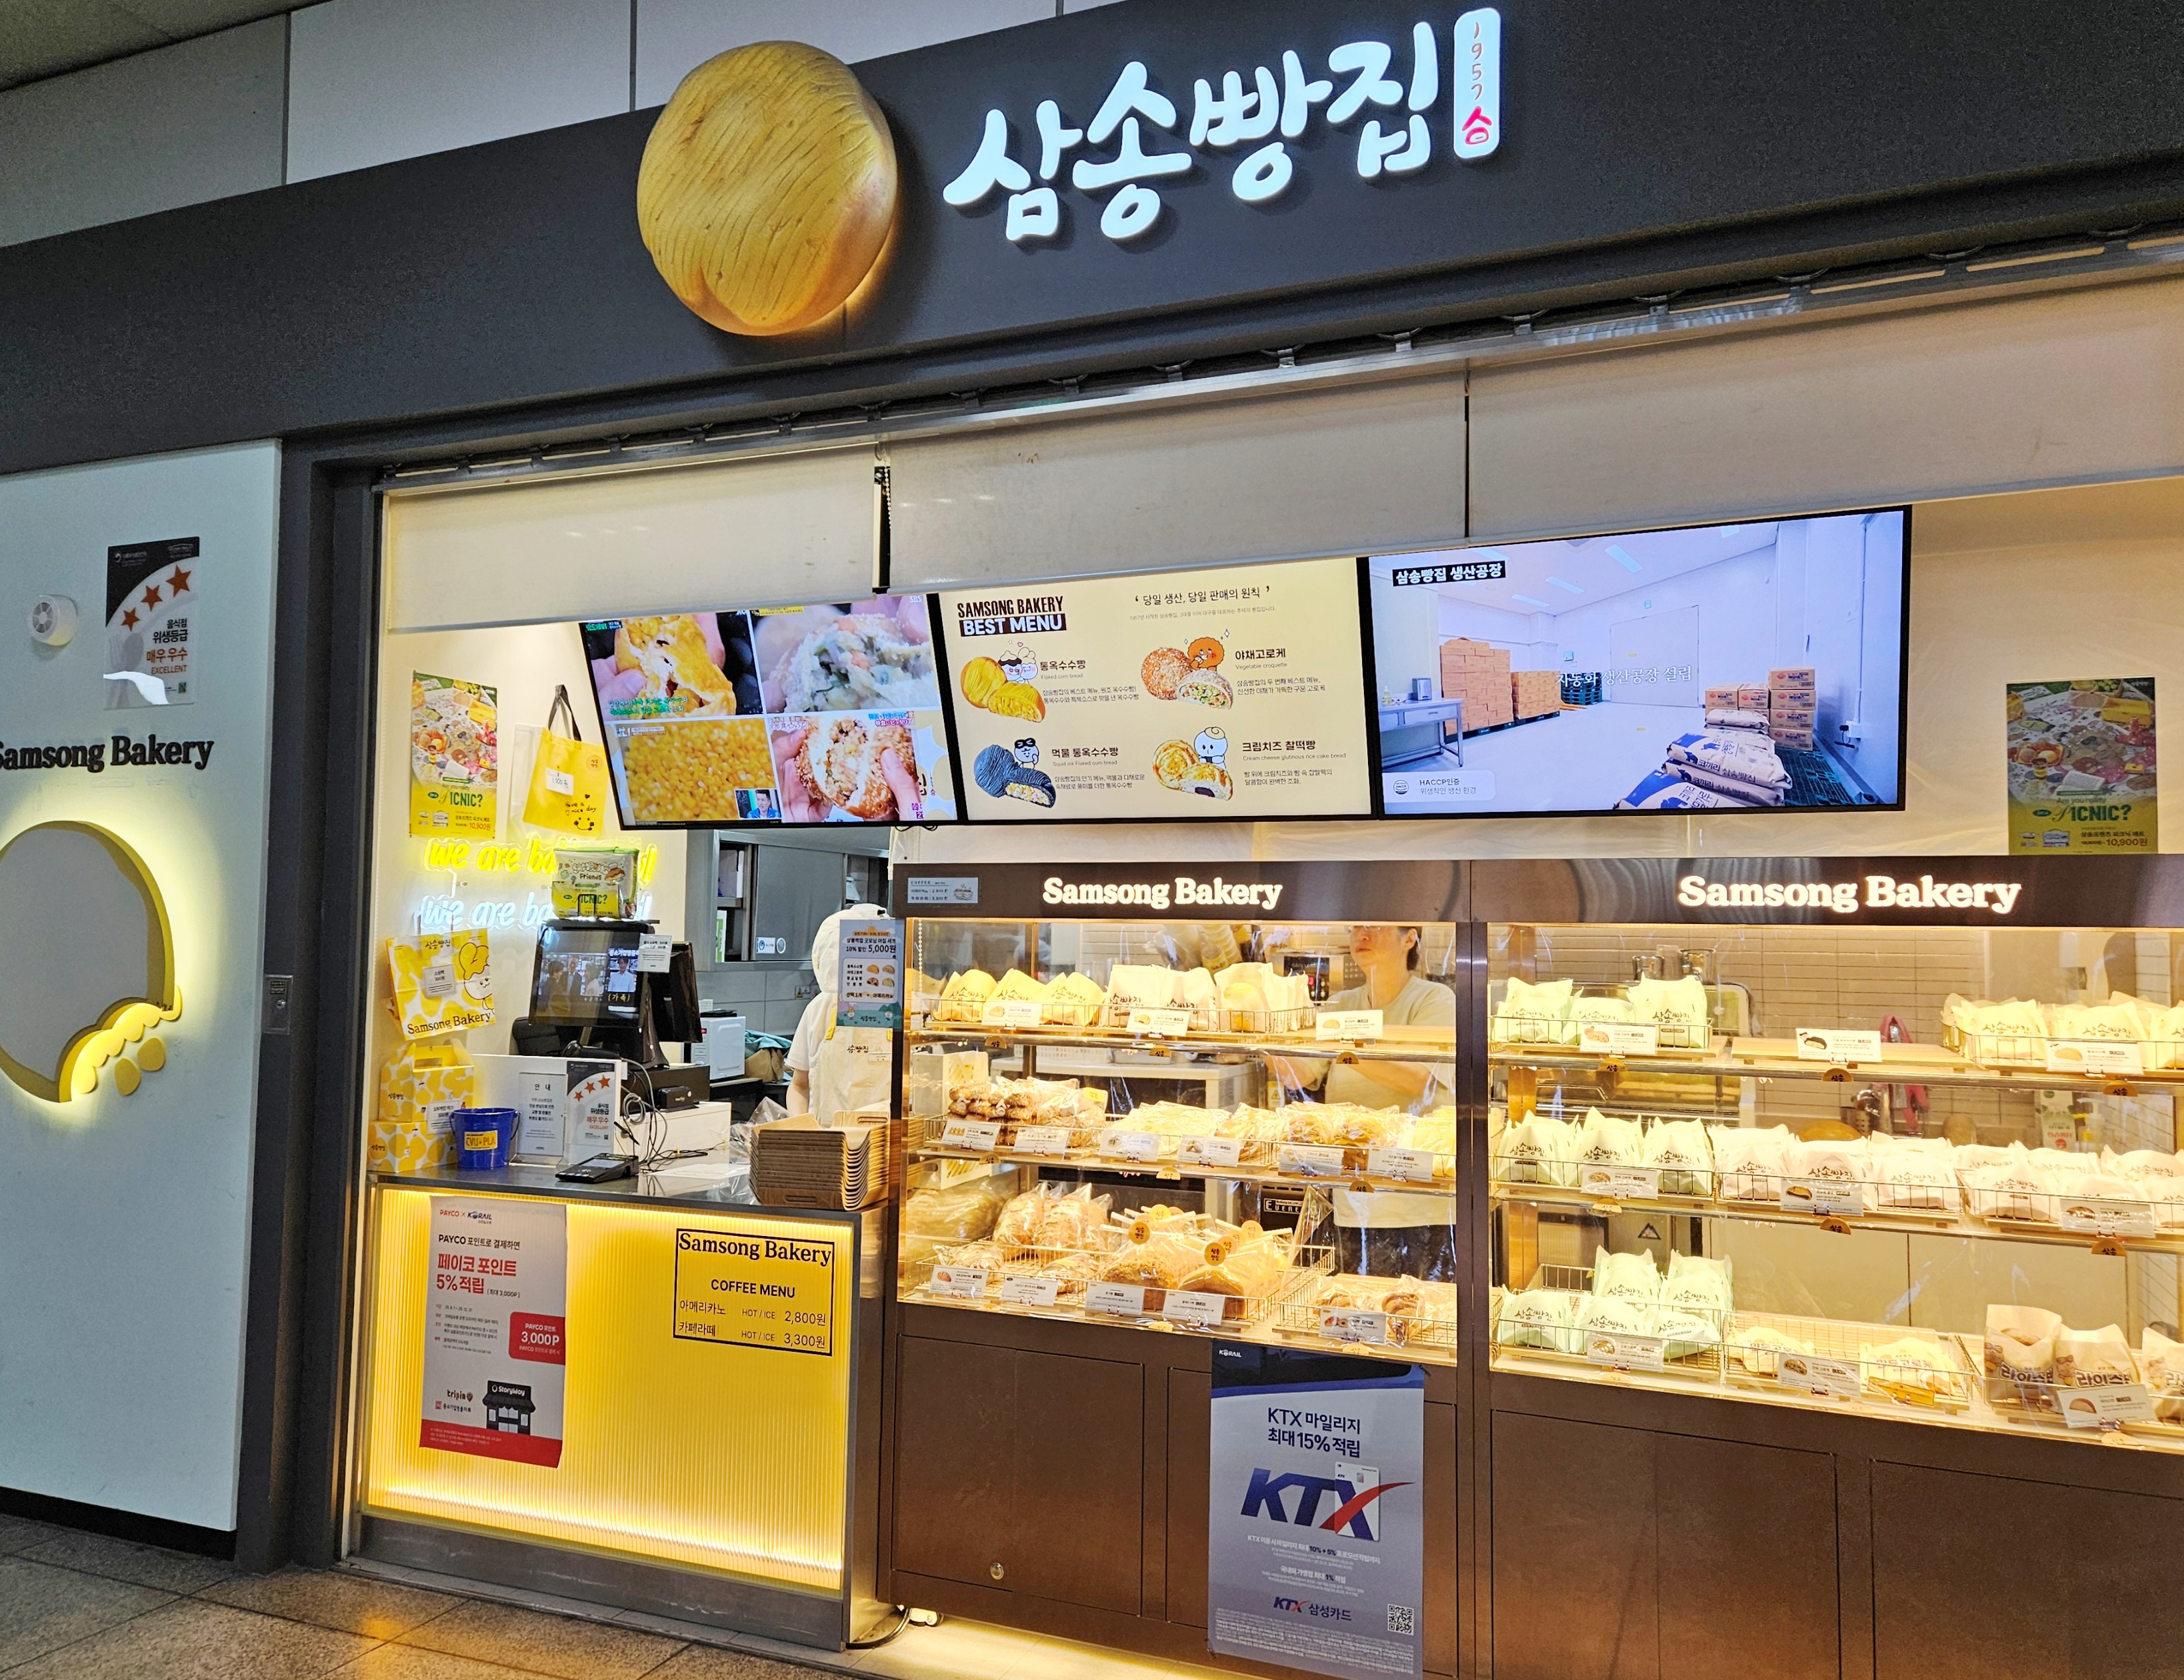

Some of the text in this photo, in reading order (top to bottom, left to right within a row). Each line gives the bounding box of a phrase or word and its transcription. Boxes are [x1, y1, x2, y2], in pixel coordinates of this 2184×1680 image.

[1471, 22, 1482, 100] 1957
[943, 21, 1437, 241] 삼송빵집
[1396, 561, 1503, 585] 삼송빵집 생산공장
[1143, 587, 1260, 605] 당일 생산, 당일 판매의 원칙
[957, 596, 1063, 618] SAMSONG BAKERY
[167, 619, 187, 629] 음식점
[963, 615, 1062, 635] BEST MENU
[153, 629, 188, 643] 위생등급
[147, 647, 187, 663] 매우 우수
[1235, 648, 1286, 660] 야채고로케
[151, 665, 187, 675] EXCELLENT
[1040, 660, 1085, 671] 통옥수수빵
[1555, 664, 1693, 688] 자동화 생산공장 설립
[111, 734, 215, 770] Bakery
[1051, 747, 1118, 758] 먹물 통옥수수빵
[1243, 740, 1315, 752] 크림치즈 찰떡빵
[1699, 759, 1756, 783] 코끼리 삼송빵집
[1419, 777, 1460, 787] HACCP인증
[1419, 786, 1477, 795] 위생적인 생산 환경
[469, 823, 491, 831] 10,900원
[2106, 838, 2148, 847] 10,900원
[428, 839, 470, 869] we
[477, 844, 522, 872] are
[1043, 877, 1283, 910] Samsong Bakery
[1678, 875, 2022, 914] Samsong Bakery
[421, 898, 516, 927] we are
[425, 939, 451, 949] 삼송빵집
[868, 945, 896, 953] 5,000원
[1652, 1008, 1692, 1023] 삼송빵집
[407, 1013, 491, 1034] Samsong Bakery
[1982, 1021, 2032, 1035] 삼송빵집
[2082, 1023, 2134, 1038] 삼송빵집
[1509, 1142, 1547, 1157] 삼송빵집
[1583, 1146, 1623, 1161] 삼송빵집
[1653, 1149, 1695, 1165] 삼송빵집
[1808, 1165, 1855, 1180] 삼송빵집
[1993, 1179, 2038, 1192] 삼송빵집
[440, 1209, 492, 1220] PAYCO KORAIL
[438, 1235, 520, 1250] PAYCO 포인트로 결제하면
[679, 1233, 831, 1267] Samsong Bakery
[437, 1253, 517, 1277] 페이코 포인트
[436, 1274, 457, 1291] 5%
[459, 1276, 485, 1294] 적립
[711, 1279, 795, 1298] COFFEE MENU
[1607, 1284, 1645, 1298] 삼송빵집
[1673, 1290, 1711, 1305] 삼송빵집
[679, 1300, 726, 1315] 아메리카노
[742, 1309, 757, 1317] HOT
[764, 1311, 776, 1319] ICE
[785, 1311, 826, 1326] 2,800원
[1515, 1307, 1554, 1322] 삼송빵집
[525, 1323, 543, 1331] PAYCO
[1588, 1315, 1629, 1331] 삼송빵집
[521, 1331, 559, 1346] 3,000P
[679, 1321, 716, 1337] 카페라떼
[741, 1331, 757, 1339] HOT
[763, 1333, 775, 1341] ICE
[784, 1333, 825, 1349] 3,300원
[1219, 1349, 1242, 1357] KORAIL
[447, 1386, 525, 1401] tripin StoryWay
[1267, 1407, 1361, 1434] KTX 마일리지
[1268, 1427, 1360, 1458] 최대 15% 적립
[1241, 1467, 1415, 1541] KTX
[1273, 1596, 1352, 1621] KTX 삼성카드
